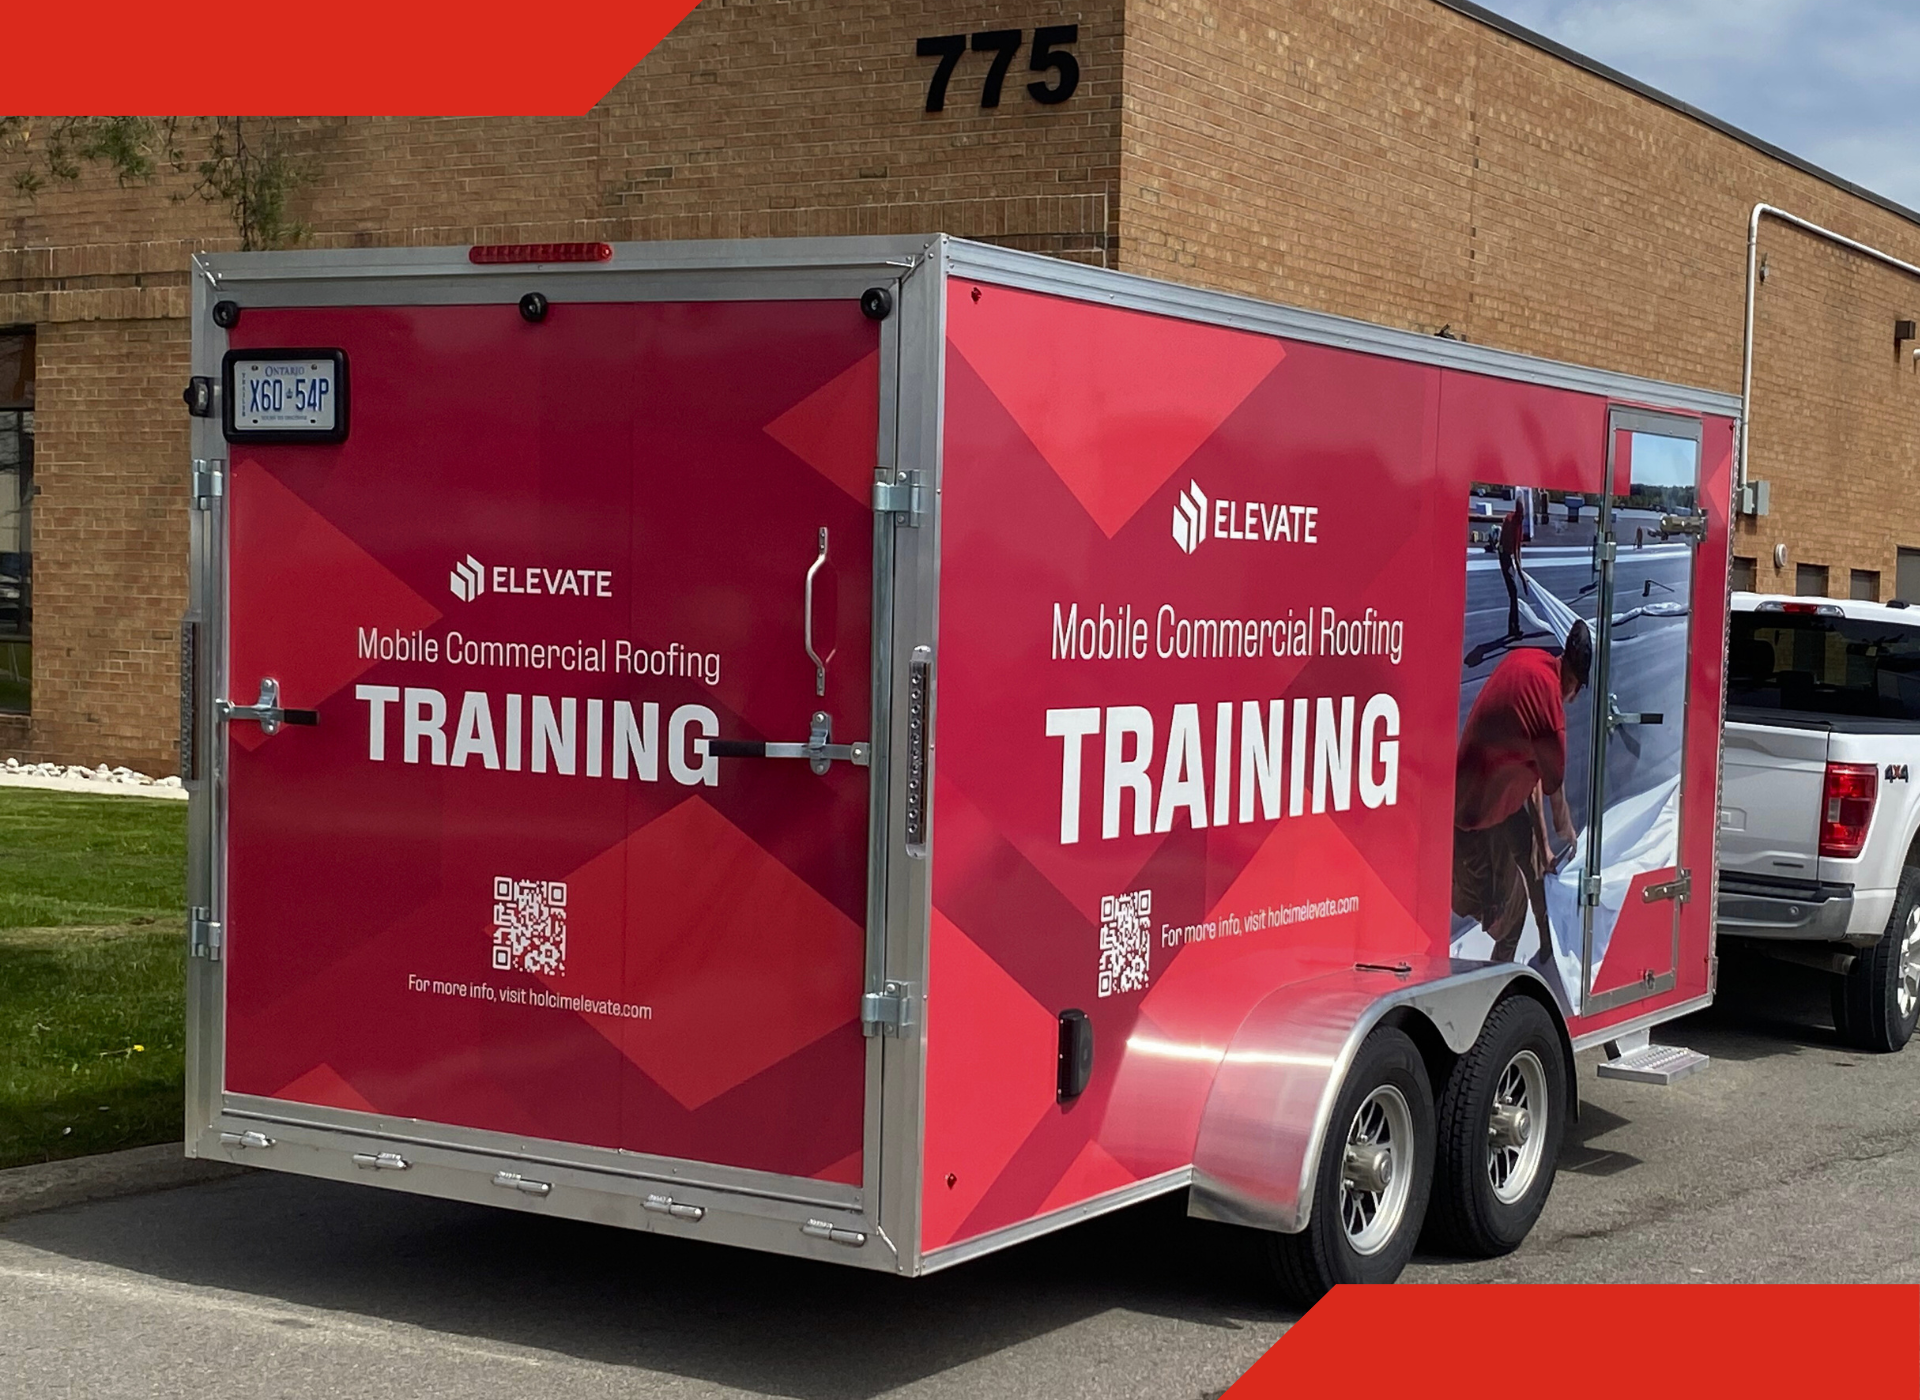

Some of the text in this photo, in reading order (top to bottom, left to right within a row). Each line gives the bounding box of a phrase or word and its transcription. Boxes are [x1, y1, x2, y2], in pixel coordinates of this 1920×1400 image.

[916, 24, 1080, 113] 775
[265, 366, 305, 377] ONTARIO
[295, 378, 329, 412] 54P
[1214, 499, 1318, 544] ELEVATE
[493, 566, 612, 597] ELEVATE
[358, 626, 721, 686] Mobile Commercial Roofing
[1052, 602, 1404, 665] Mobile Commercial Roofing
[355, 684, 720, 787] TRAINING
[1045, 693, 1401, 845] TRAINING
[1161, 895, 1359, 948] For more info, visit holcimelevate.com
[408, 974, 652, 1020] For more info, visit holcimelevate.com
